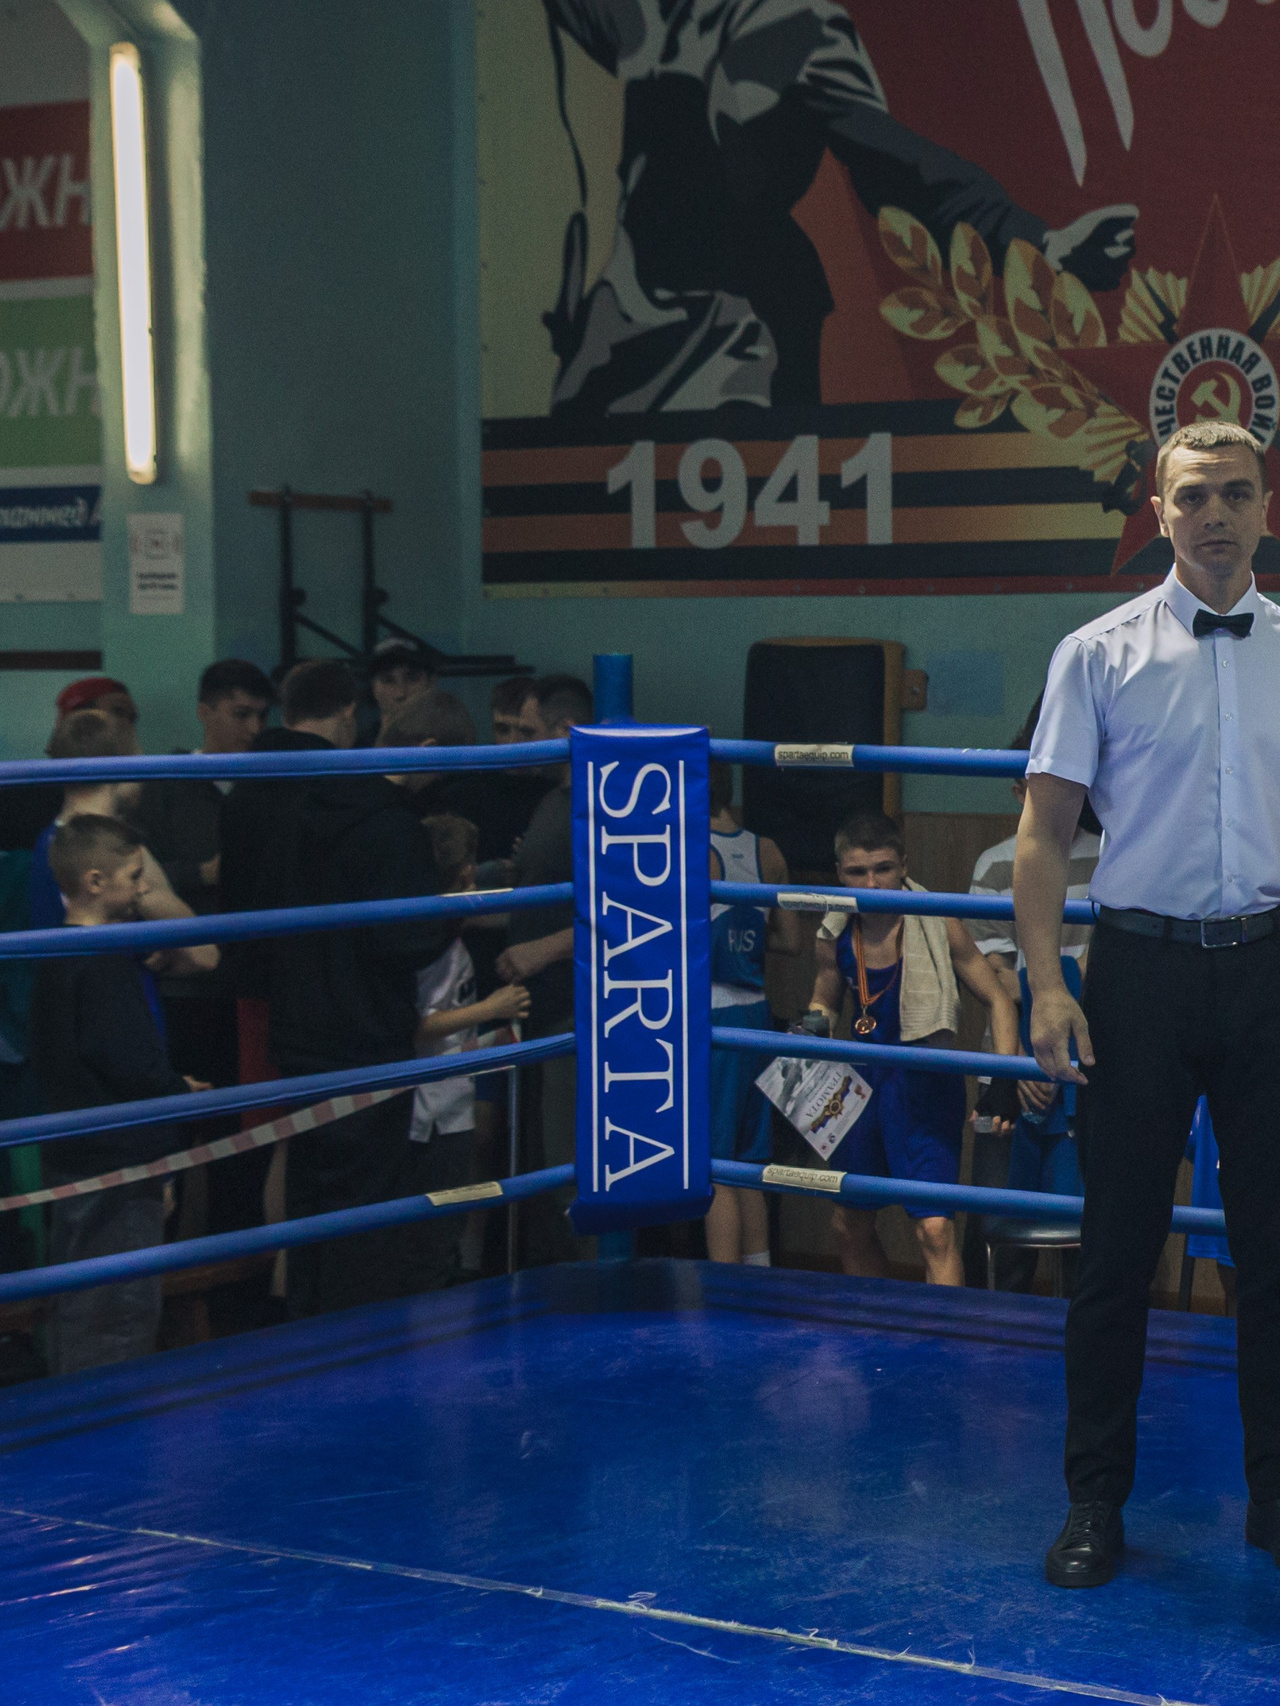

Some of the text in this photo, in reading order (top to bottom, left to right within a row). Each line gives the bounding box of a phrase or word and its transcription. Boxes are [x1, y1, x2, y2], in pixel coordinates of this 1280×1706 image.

[0, 347, 101, 417] ЖН
[1155, 334, 1261, 438] ЧЕСТВЕННАЯ
[606, 432, 893, 549] 1941
[599, 760, 676, 1193] SPARTA
